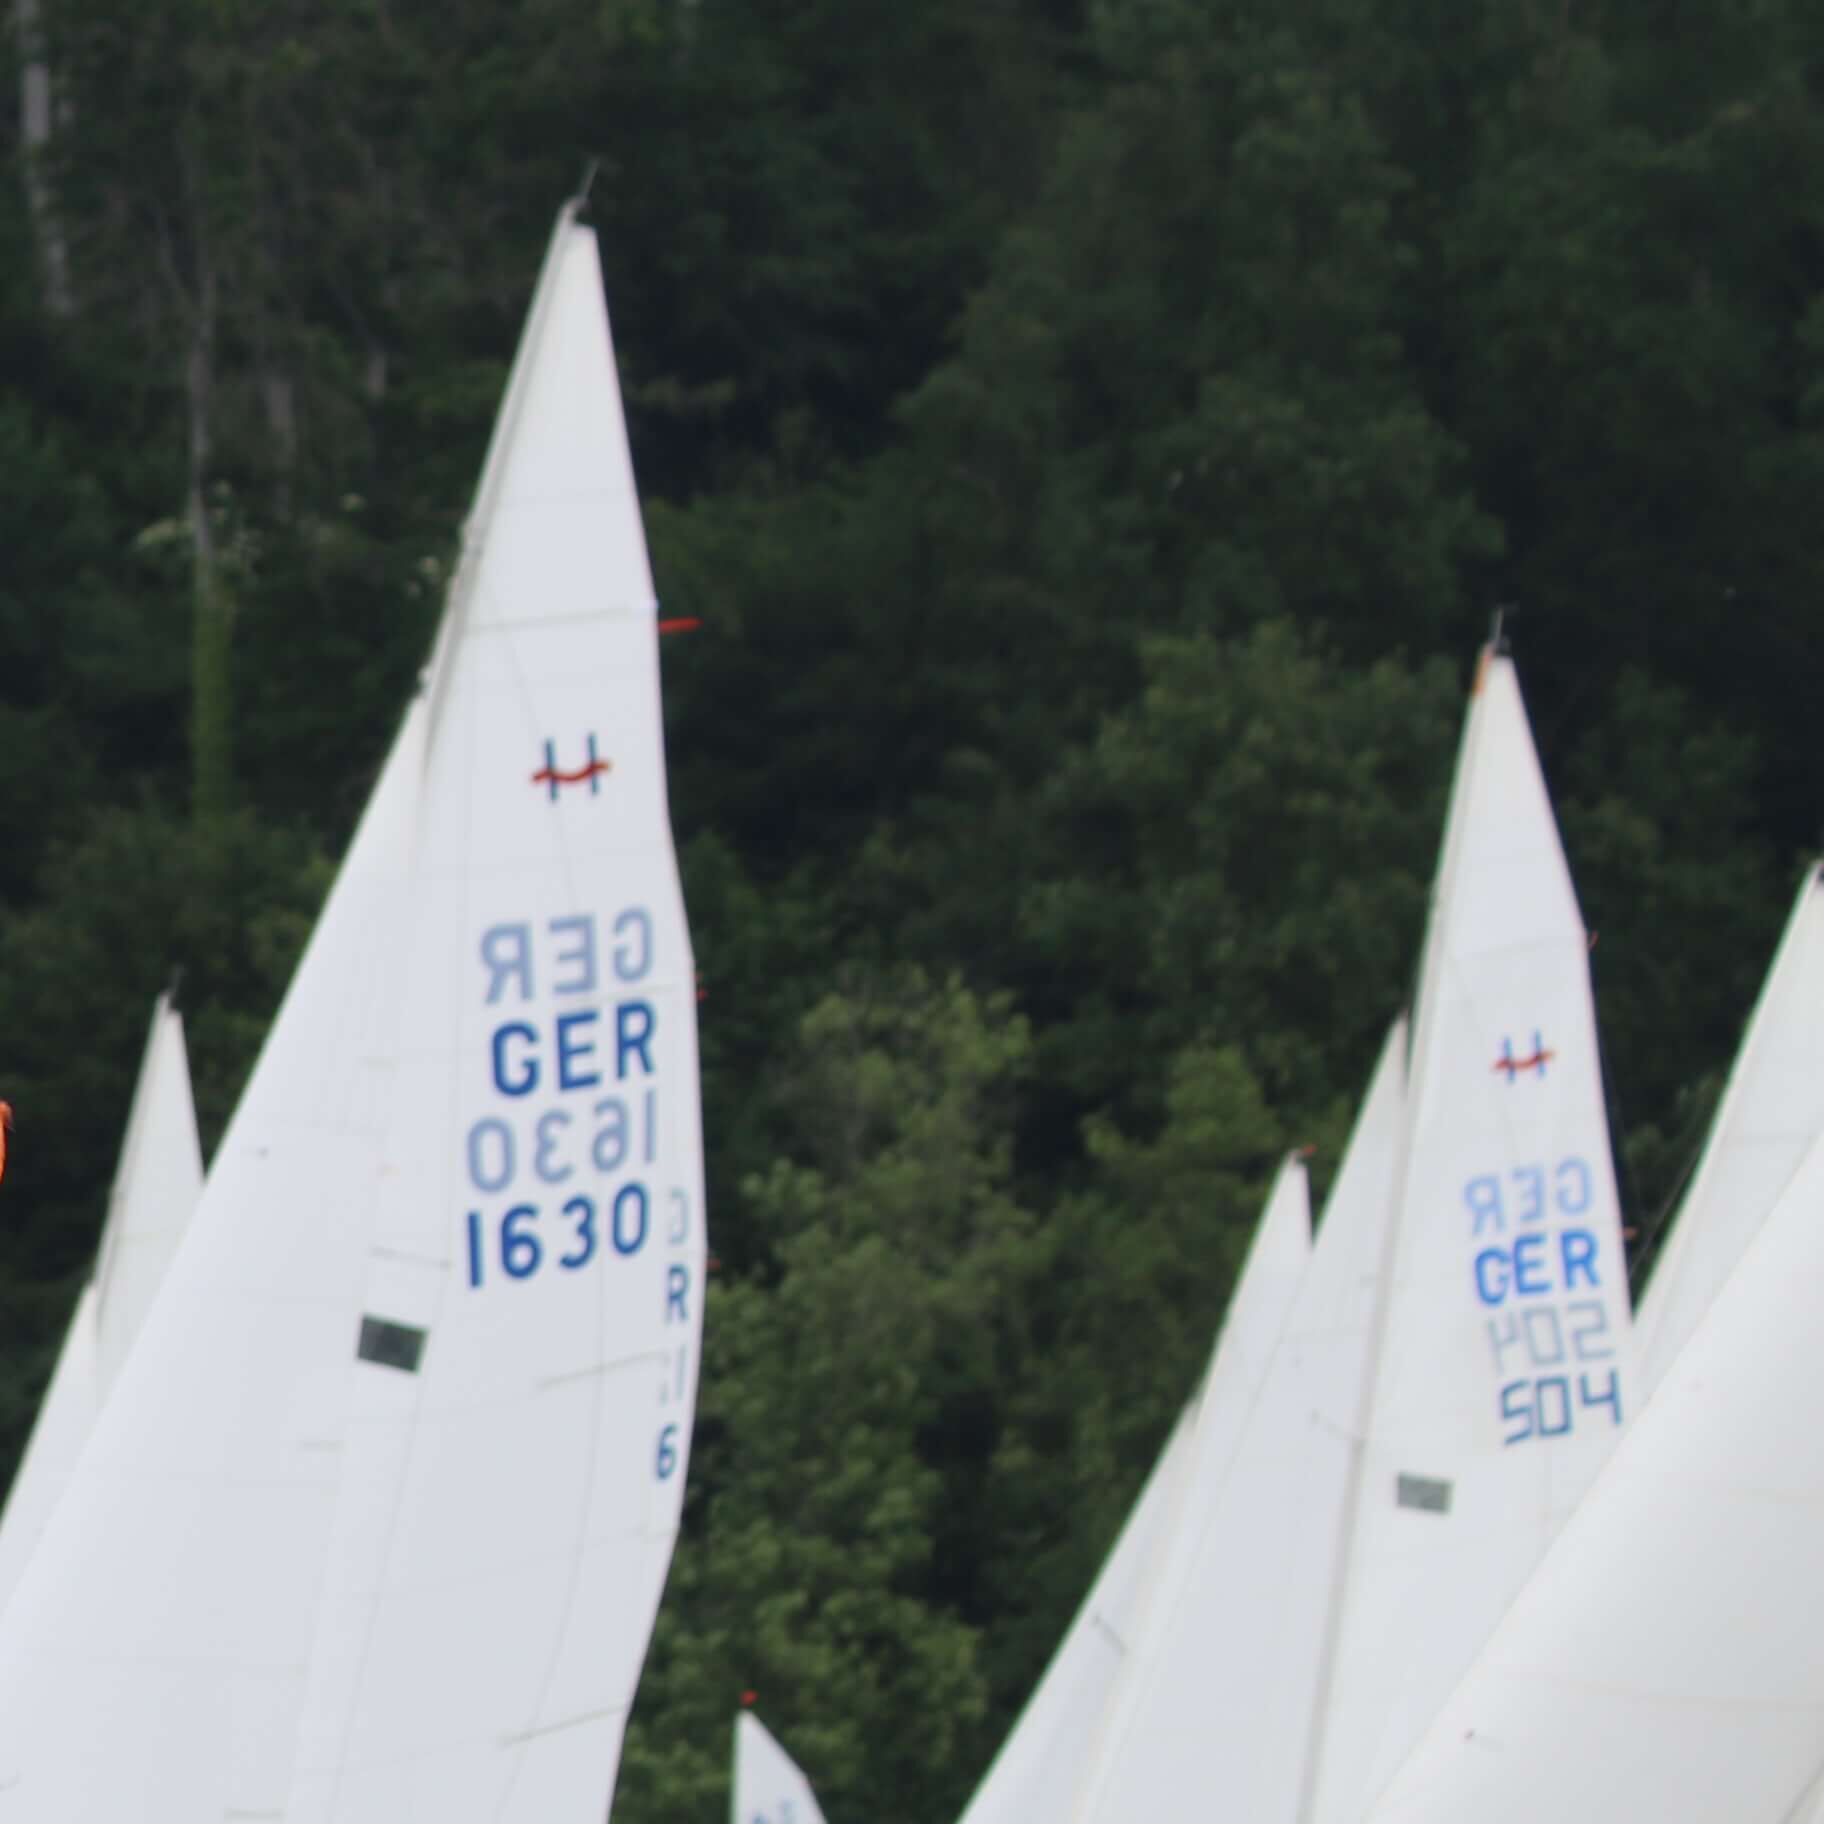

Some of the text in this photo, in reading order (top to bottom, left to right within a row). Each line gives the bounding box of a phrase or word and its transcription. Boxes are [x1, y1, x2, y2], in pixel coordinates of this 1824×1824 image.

[491, 1000, 657, 1097] GER
[464, 1182, 649, 1289] 1630
[1473, 1228, 1601, 1307] GER
[1499, 1368, 1623, 1446] 504
